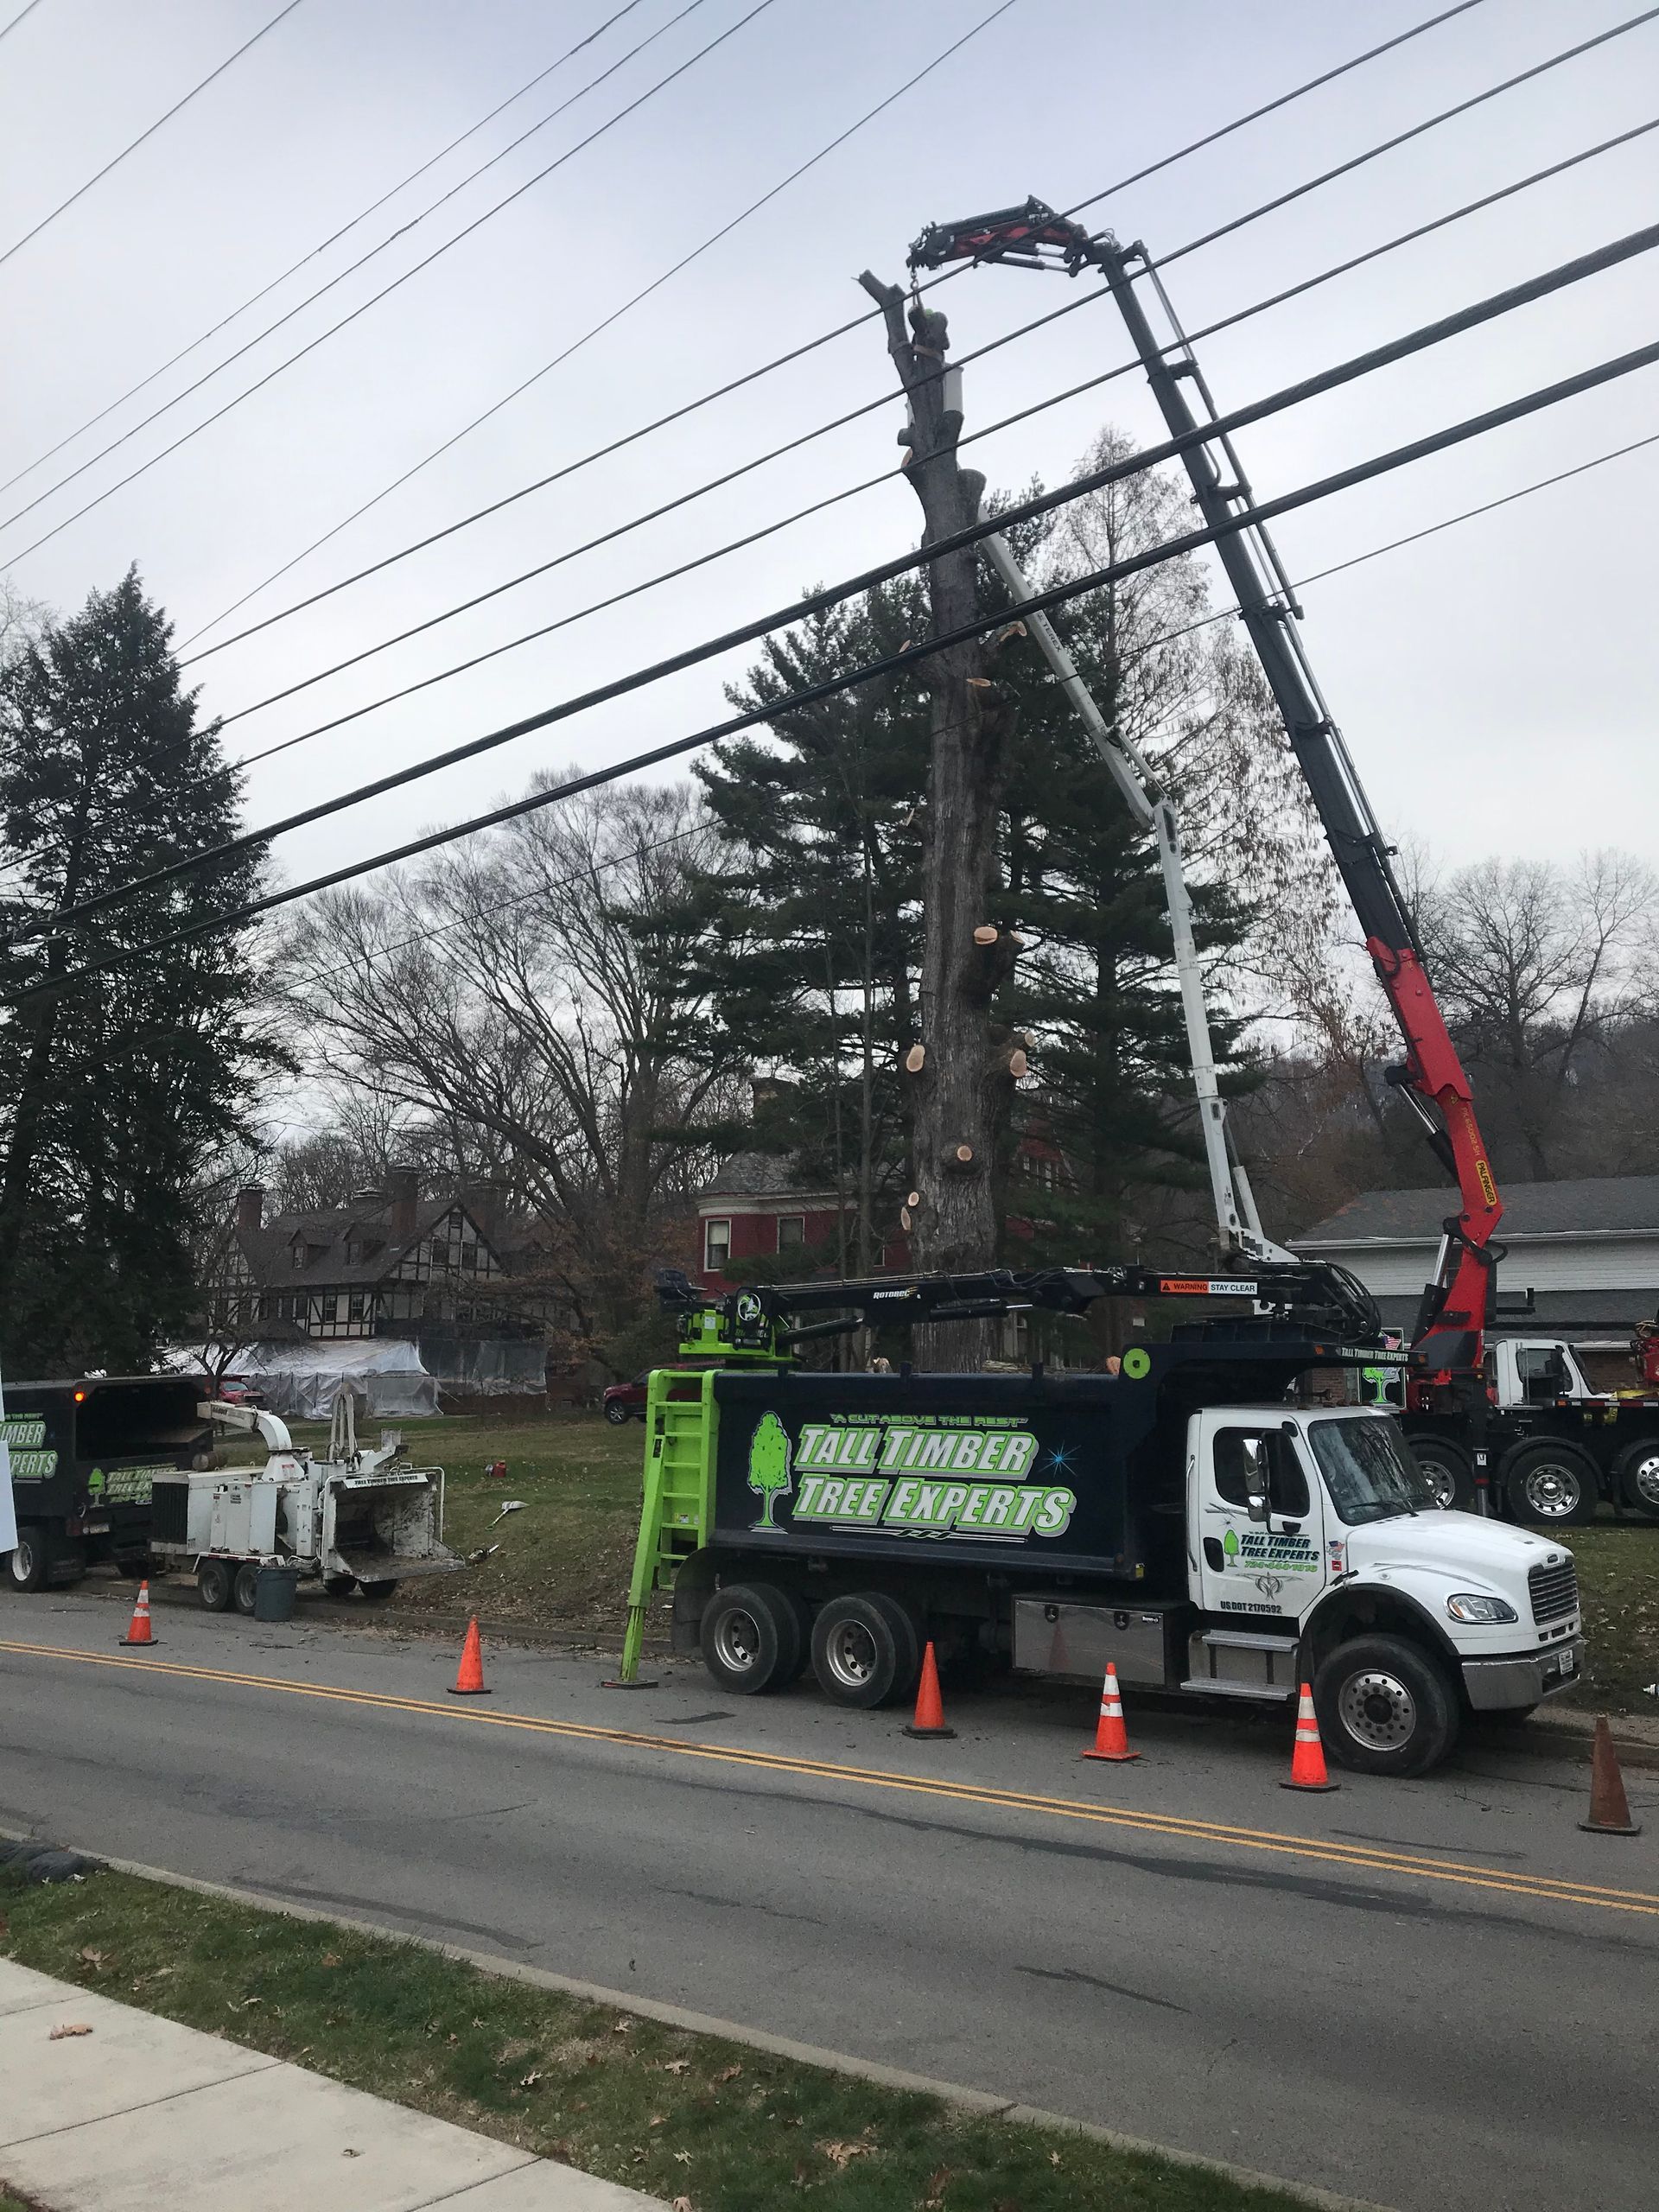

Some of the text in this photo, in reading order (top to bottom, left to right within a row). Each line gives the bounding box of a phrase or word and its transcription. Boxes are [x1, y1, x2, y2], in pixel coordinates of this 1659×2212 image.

[1043, 622, 1062, 652] TEREX
[1478, 1162, 1495, 1203] PALFINGER
[938, 1415, 972, 1426] THE
[794, 1424, 1039, 1480] TALL TIMBER
[791, 1474, 1077, 1537] TREE EXPERTS
[1241, 1535, 1312, 1548] TALL TIMBER
[1241, 1546, 1320, 1561] TREE EXPERTS
[1220, 1600, 1230, 1610] US
[1231, 1601, 1247, 1611] DOT
